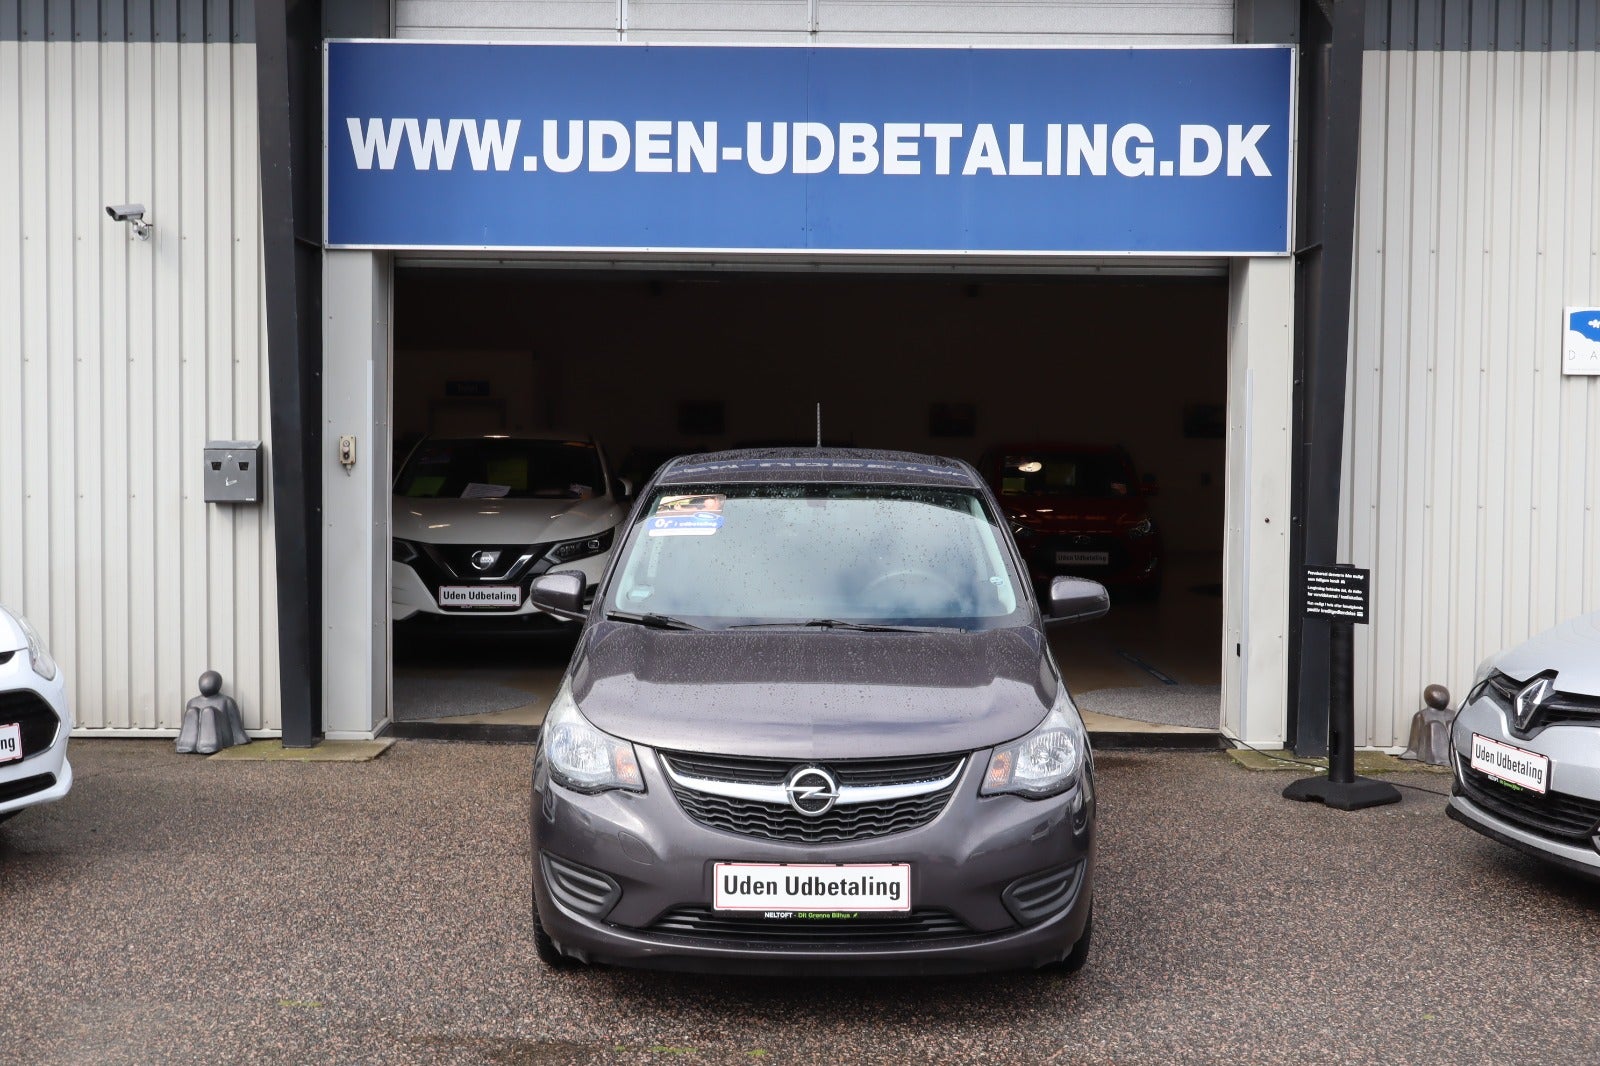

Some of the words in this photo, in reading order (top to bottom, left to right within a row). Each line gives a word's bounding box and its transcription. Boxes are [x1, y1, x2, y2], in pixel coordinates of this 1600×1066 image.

[346, 117, 1273, 177] WWW.UDEN-UDBETALING.DK
[443, 590, 466, 600] Uden
[468, 590, 517, 602] Udbetaling
[1475, 742, 1495, 764] Uden
[1496, 753, 1544, 785] Udbetaling
[723, 874, 778, 896] Uden
[785, 875, 901, 901] Udbetaling
[764, 911, 793, 919] NELTOFT
